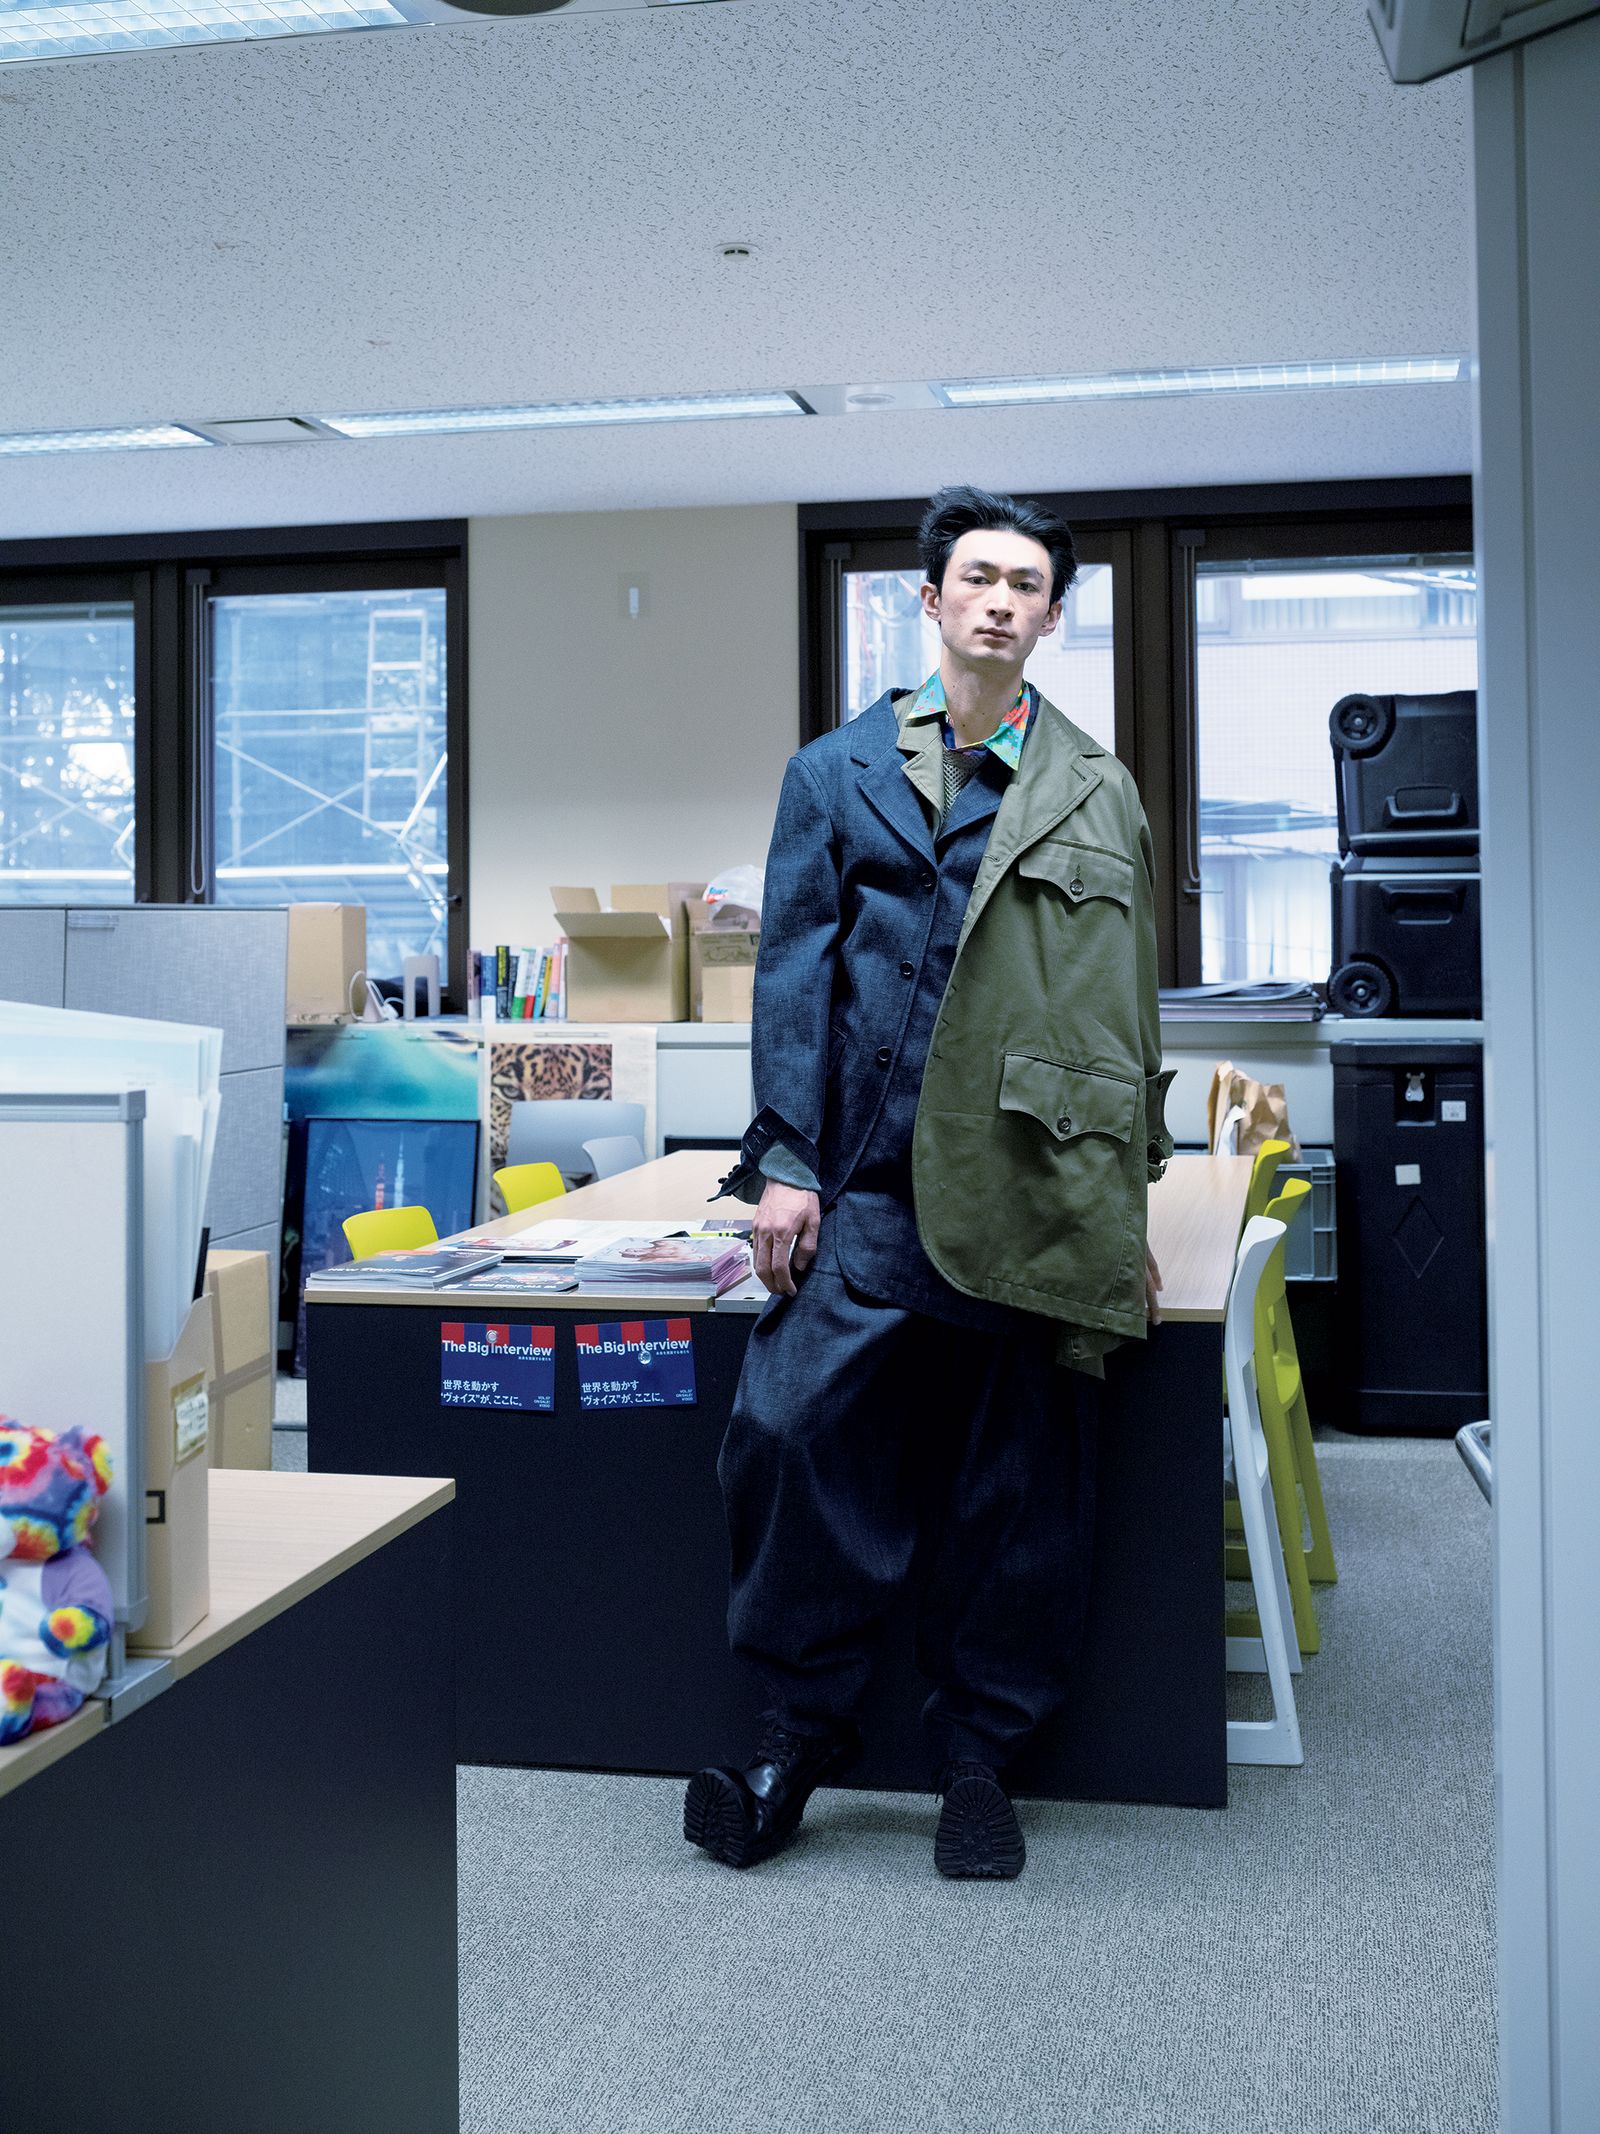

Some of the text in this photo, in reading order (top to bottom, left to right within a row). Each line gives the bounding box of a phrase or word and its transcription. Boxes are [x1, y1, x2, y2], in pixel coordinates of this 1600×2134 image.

[442, 1340, 552, 1356] The Big Interview
[577, 1338, 689, 1355] The Big Interview
[443, 1380, 499, 1393] 世界を動かす
[581, 1380, 639, 1393] 世界を動かす
